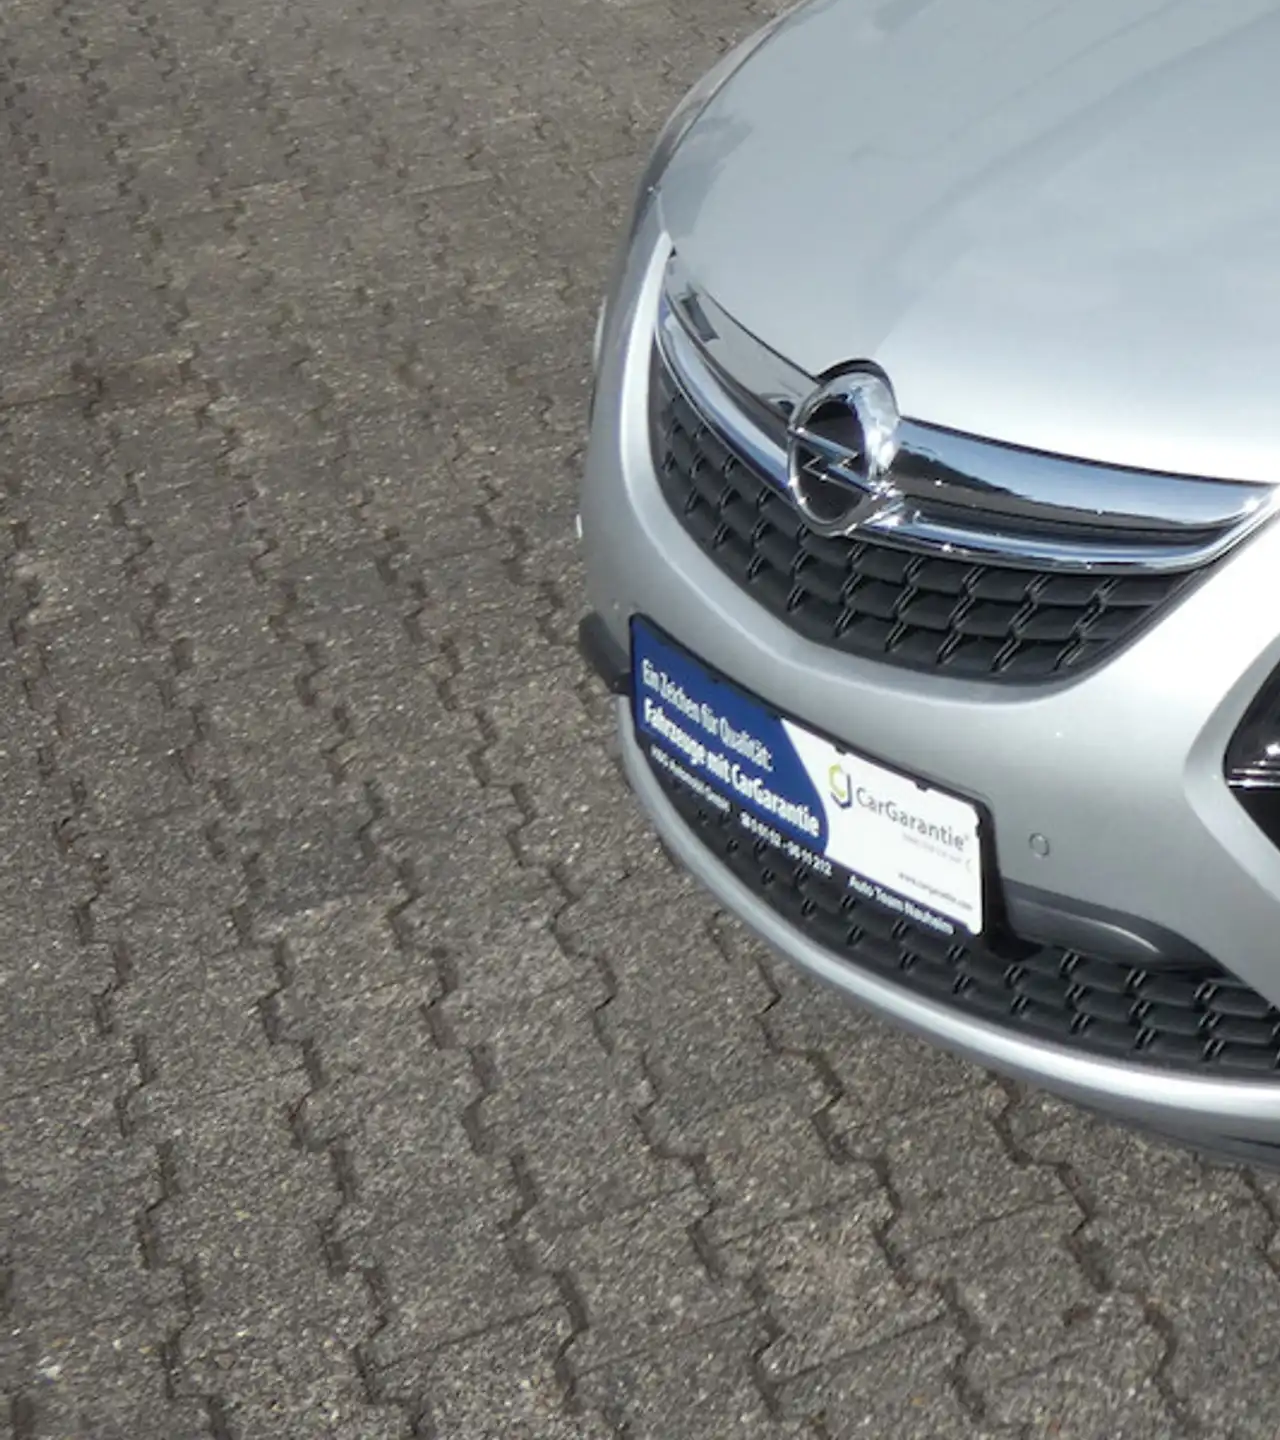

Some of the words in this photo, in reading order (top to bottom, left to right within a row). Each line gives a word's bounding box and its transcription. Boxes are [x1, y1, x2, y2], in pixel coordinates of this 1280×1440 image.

[643, 658, 659, 692] Ein
[660, 671, 700, 723] Zeichen
[701, 703, 719, 735] für
[720, 716, 774, 772] Qualität:
[644, 697, 705, 766] Fahrzeuge
[706, 750, 731, 785] mit
[732, 762, 820, 839] CarGarantie
[856, 787, 964, 852] CarGarantie
[849, 874, 875, 899] Auto
